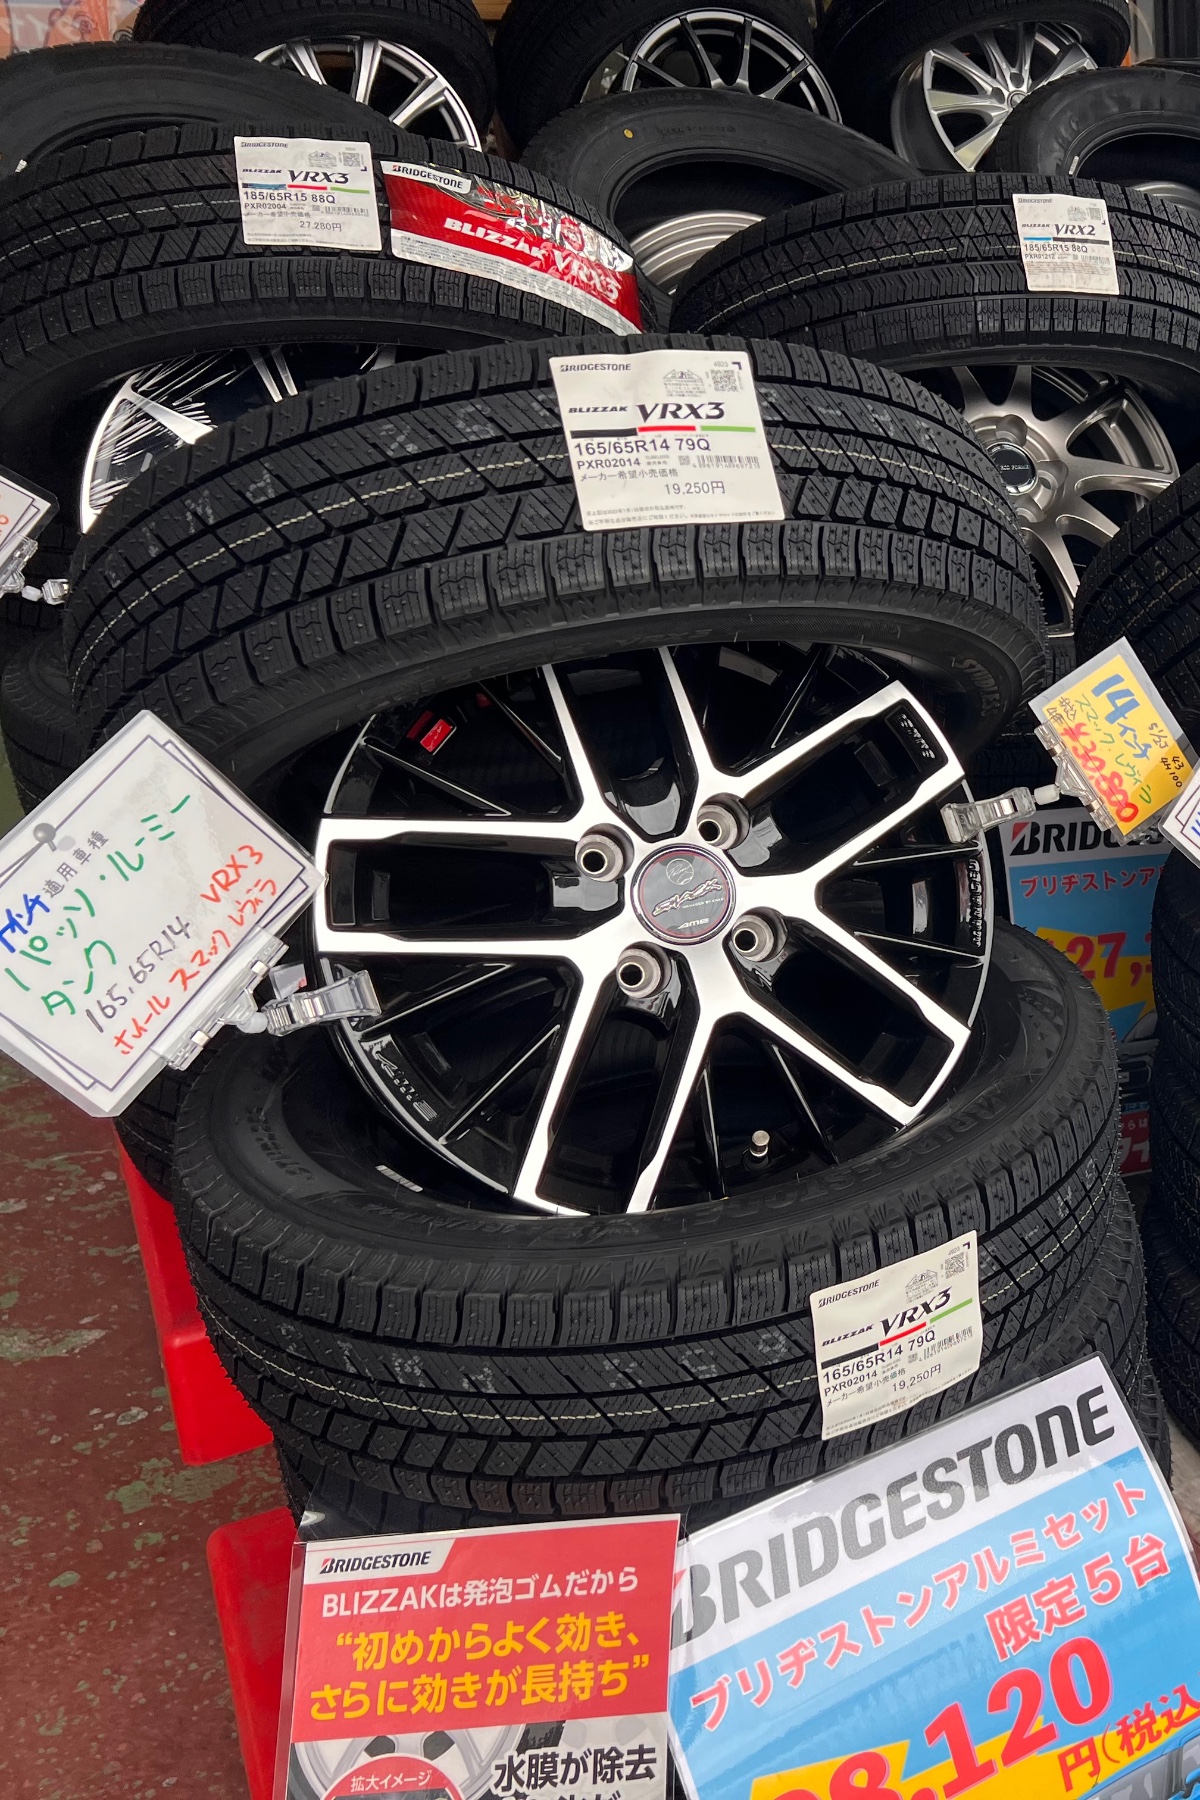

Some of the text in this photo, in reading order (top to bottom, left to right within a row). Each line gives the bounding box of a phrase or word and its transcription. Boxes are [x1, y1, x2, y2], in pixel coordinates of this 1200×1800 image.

[288, 170, 349, 184] VRX3
[391, 164, 463, 189] BRIDGESTONE
[243, 191, 336, 204] 185/65R15 88Q
[1054, 224, 1096, 236] VRX2
[444, 217, 548, 262] BLIZZAK
[551, 251, 622, 302] VRX3
[1024, 244, 1088, 253] 185/65R15 88Q
[560, 363, 632, 372] BRIDGESTONE
[636, 402, 725, 423] VRX3
[574, 438, 712, 456] 165/65R14 79Q
[577, 458, 641, 470] PXR02014
[580, 469, 679, 482] メーカー希望小売価格
[664, 481, 725, 496] 19,250円
[42, 830, 109, 899] 適用車種
[200, 845, 264, 904] VRX3
[41, 940, 117, 1016] タンク
[818, 1279, 880, 1308] BRIDGESTONE
[822, 1324, 874, 1347] BLIZZAK
[879, 1286, 953, 1338] VRX3
[823, 1330, 936, 1384] 165/65R14 79Q
[824, 1370, 878, 1397] PXR02014
[826, 1369, 906, 1407] メーカー希望小売価格
[892, 1363, 942, 1392] 19,250円
[671, 1384, 1116, 1644] BRIDGESTONE
[319, 1551, 432, 1575] BRIDGESTONE
[322, 1566, 639, 1618] BLIZZAKは発泡ゴムだから
[690, 1477, 1149, 1731] ブリヂストンアルミセット
[984, 1532, 1172, 1663] 限定5台
[350, 1770, 433, 1792] 拡大イメージ
[494, 1744, 657, 1792] 水膜が除去
